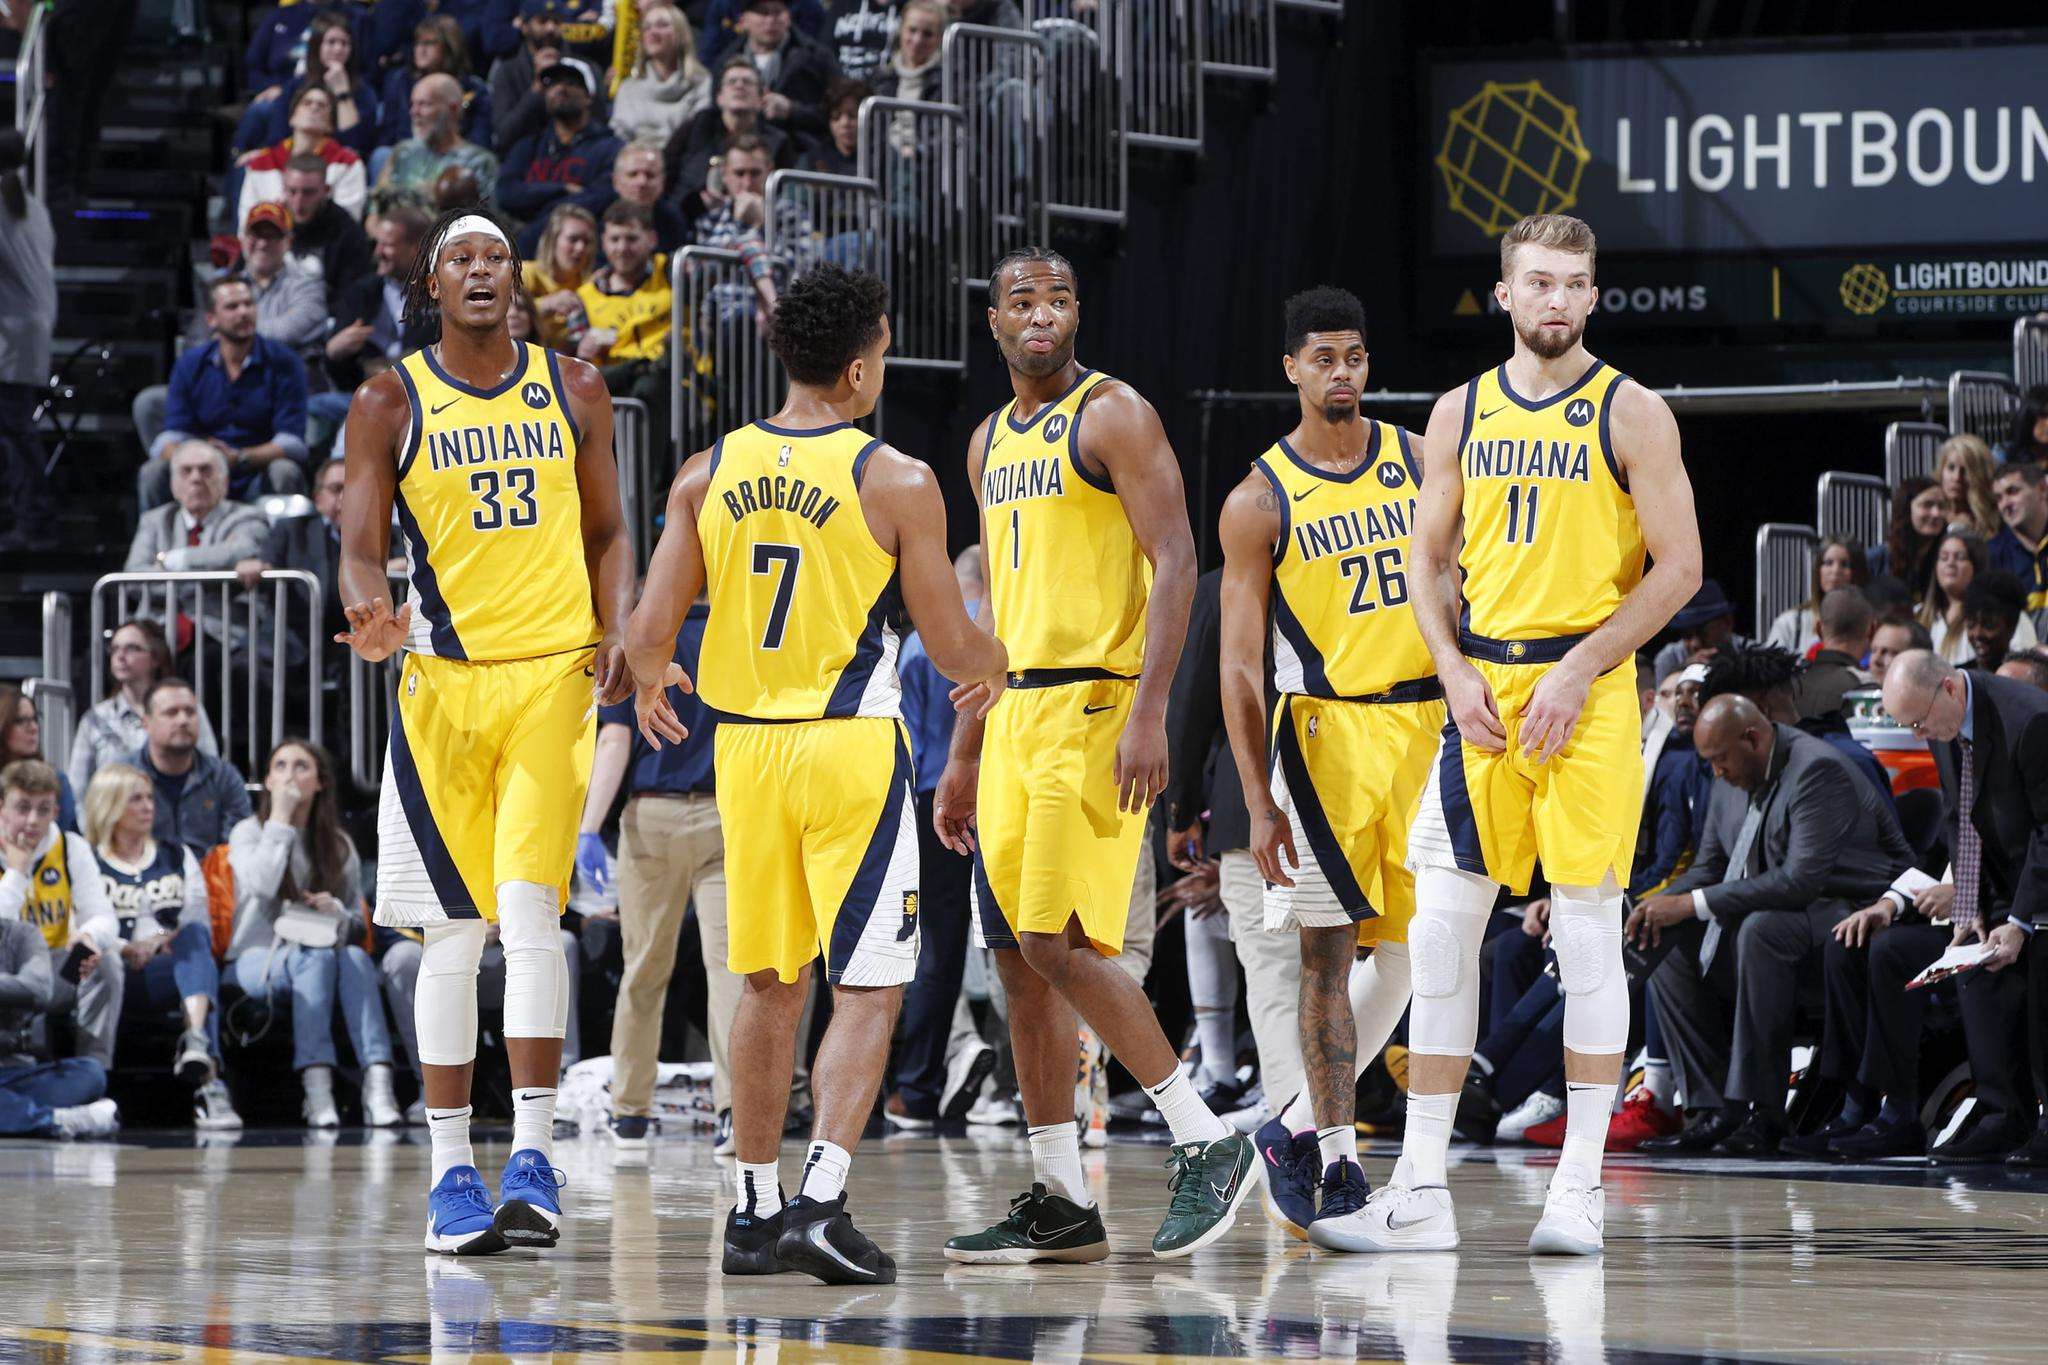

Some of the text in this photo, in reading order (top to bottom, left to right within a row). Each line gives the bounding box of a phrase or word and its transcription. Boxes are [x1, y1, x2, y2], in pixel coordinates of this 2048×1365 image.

[1894, 259, 2048, 290] LIGHTBOUND
[1895, 295, 1998, 314] COURTSIDE
[427, 421, 565, 471] INDIANA
[1468, 439, 1590, 483] INDIANA
[470, 467, 538, 531] 33
[722, 475, 841, 530] BROGDON
[982, 457, 1064, 508] INDIANA
[1011, 508, 1020, 570] 1
[1507, 483, 1539, 544] 11
[751, 542, 802, 651] 7
[1340, 548, 1409, 615] 26
